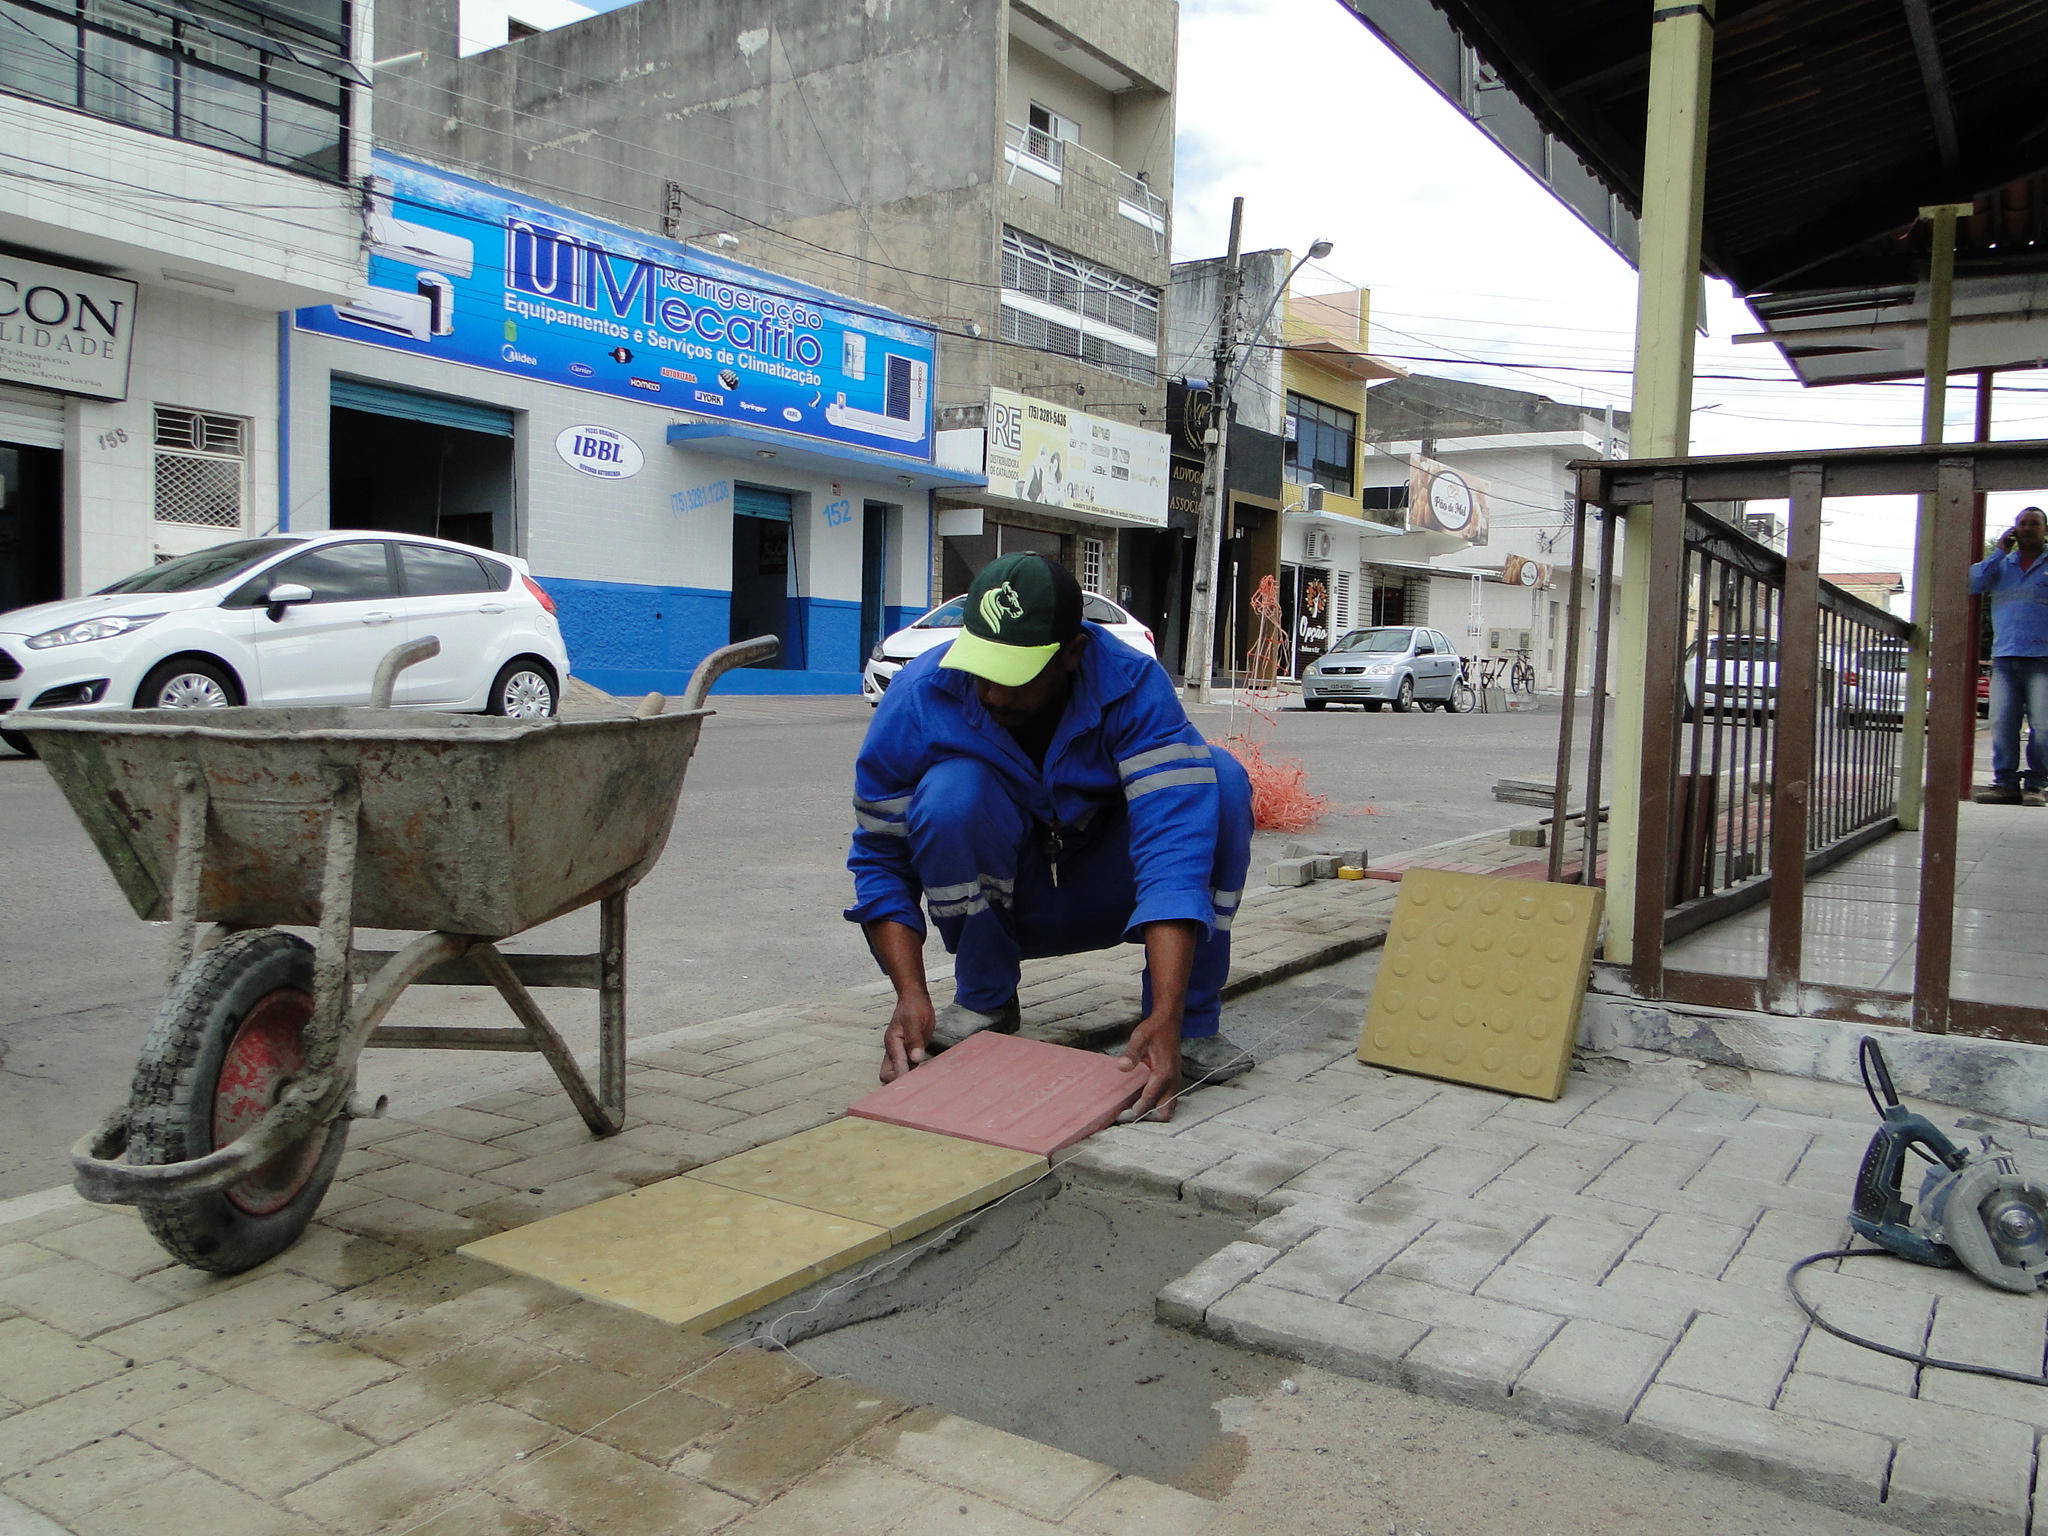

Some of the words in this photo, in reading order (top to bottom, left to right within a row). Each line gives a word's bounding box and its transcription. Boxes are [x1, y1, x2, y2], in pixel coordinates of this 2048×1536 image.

[584, 240, 823, 367] Mecafrio
[660, 266, 823, 331] Refrigeração
[503, 291, 630, 341] Equipamentos
[633, 329, 644, 343] e
[647, 328, 713, 360] Serviços
[716, 348, 735, 365] de
[739, 352, 822, 386] Climatização
[504, 345, 538, 366] Midea
[571, 364, 595, 376] Carrier
[662, 367, 697, 383] AUTORIZADA
[630, 378, 661, 392] KOMECO
[701, 392, 722, 405] YORK
[739, 401, 768, 413] Springer
[992, 402, 1022, 452] RE
[99, 428, 129, 451] 158
[573, 434, 624, 464] IBBL
[990, 453, 1020, 469] DISTRIBUIDORA
[823, 499, 852, 528] 152
[1299, 615, 1328, 643] Opção
